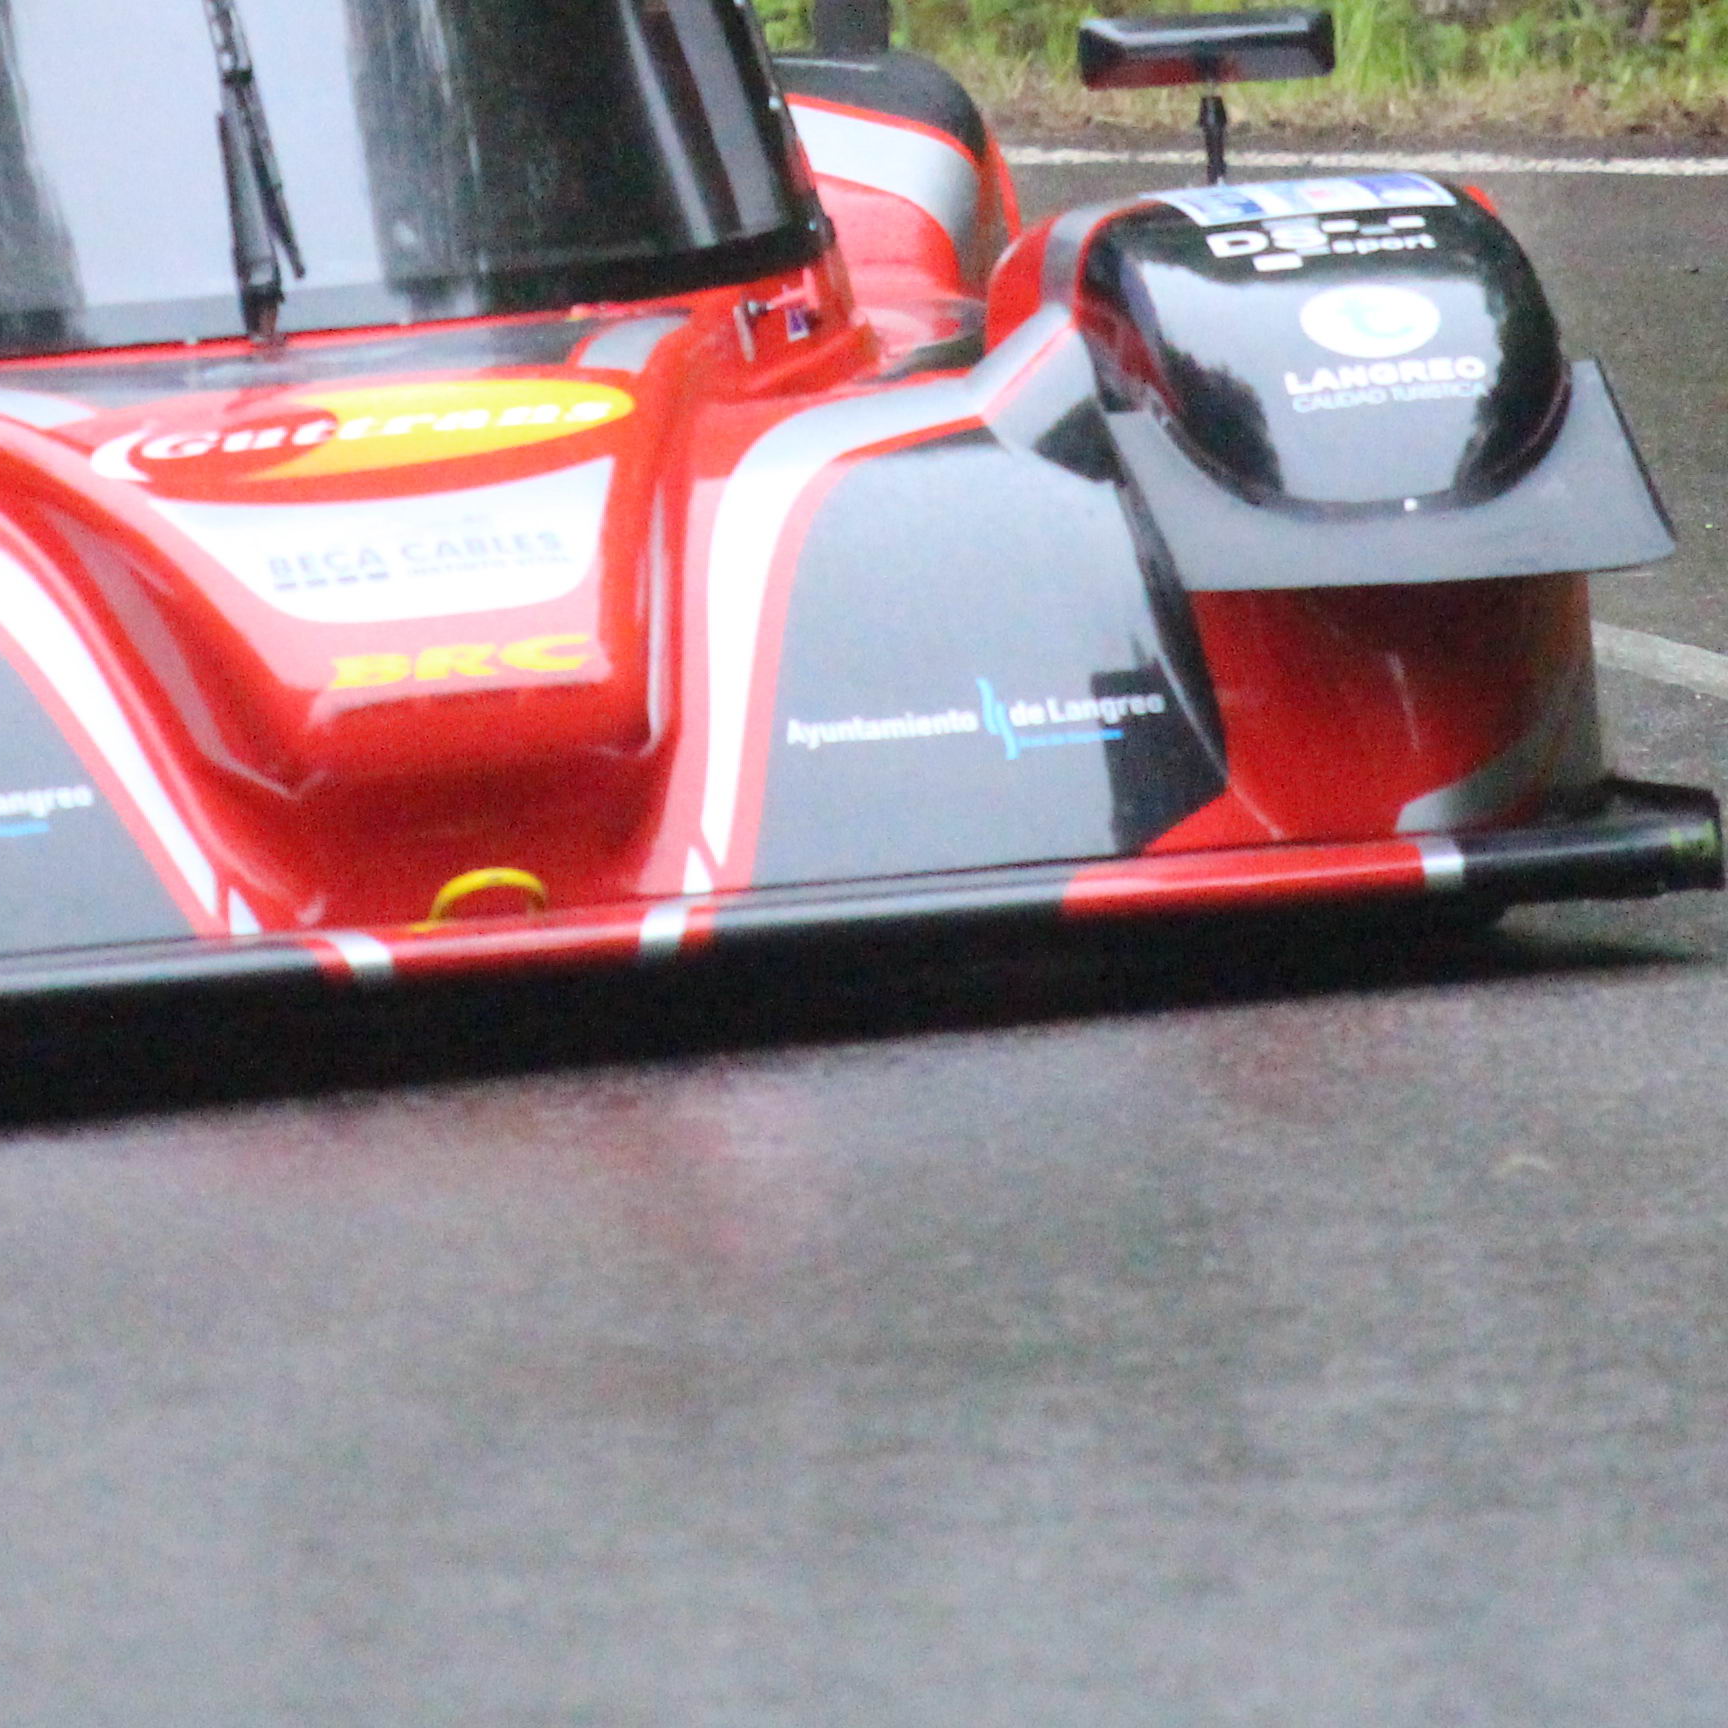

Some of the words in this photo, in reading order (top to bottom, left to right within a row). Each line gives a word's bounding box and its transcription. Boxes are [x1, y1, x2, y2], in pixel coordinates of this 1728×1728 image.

[1283, 355, 1486, 396] LANGREO
[332, 633, 590, 689] BRC
[786, 708, 980, 752] Ayuntamiento
[1008, 698, 1045, 728] de
[1047, 692, 1166, 725] Langreo
